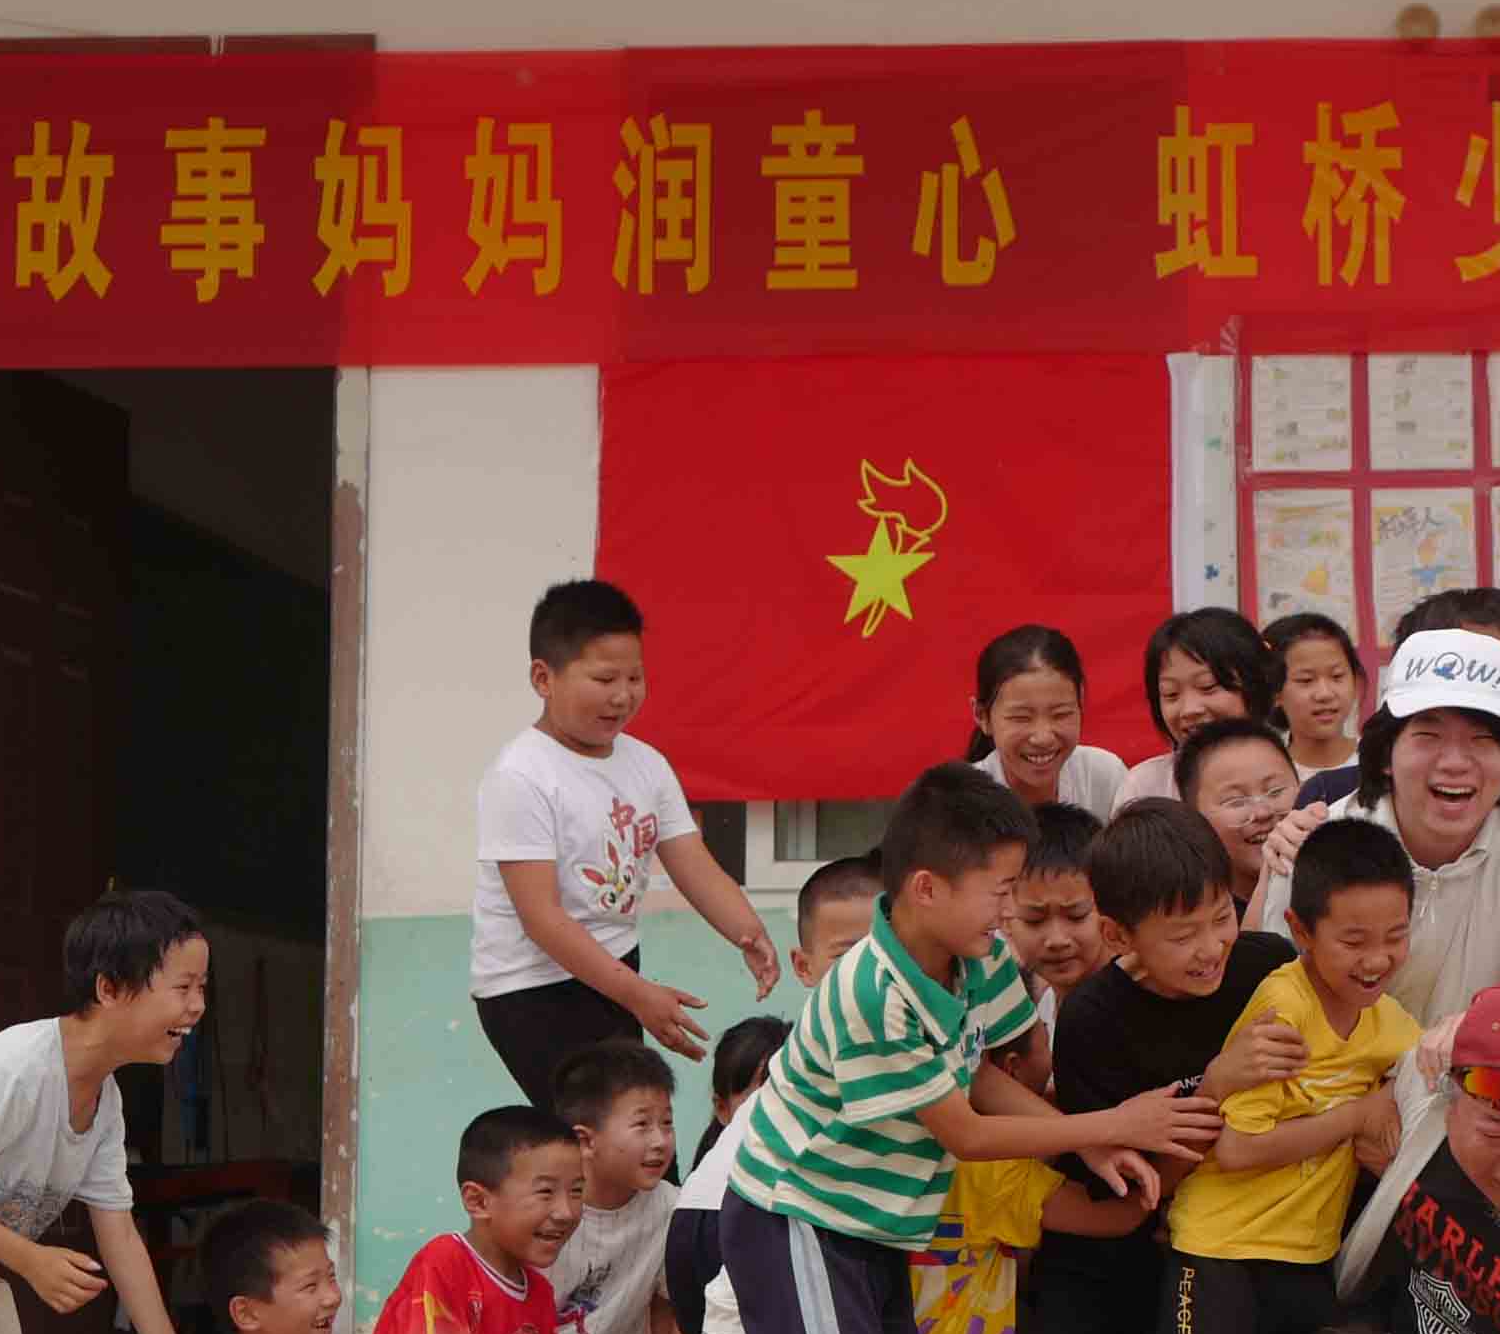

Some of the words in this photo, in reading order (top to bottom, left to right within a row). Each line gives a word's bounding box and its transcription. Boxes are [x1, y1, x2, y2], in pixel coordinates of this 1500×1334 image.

[13, 110, 1016, 303] 故事妈妈润童心
[609, 796, 658, 858] 中国
